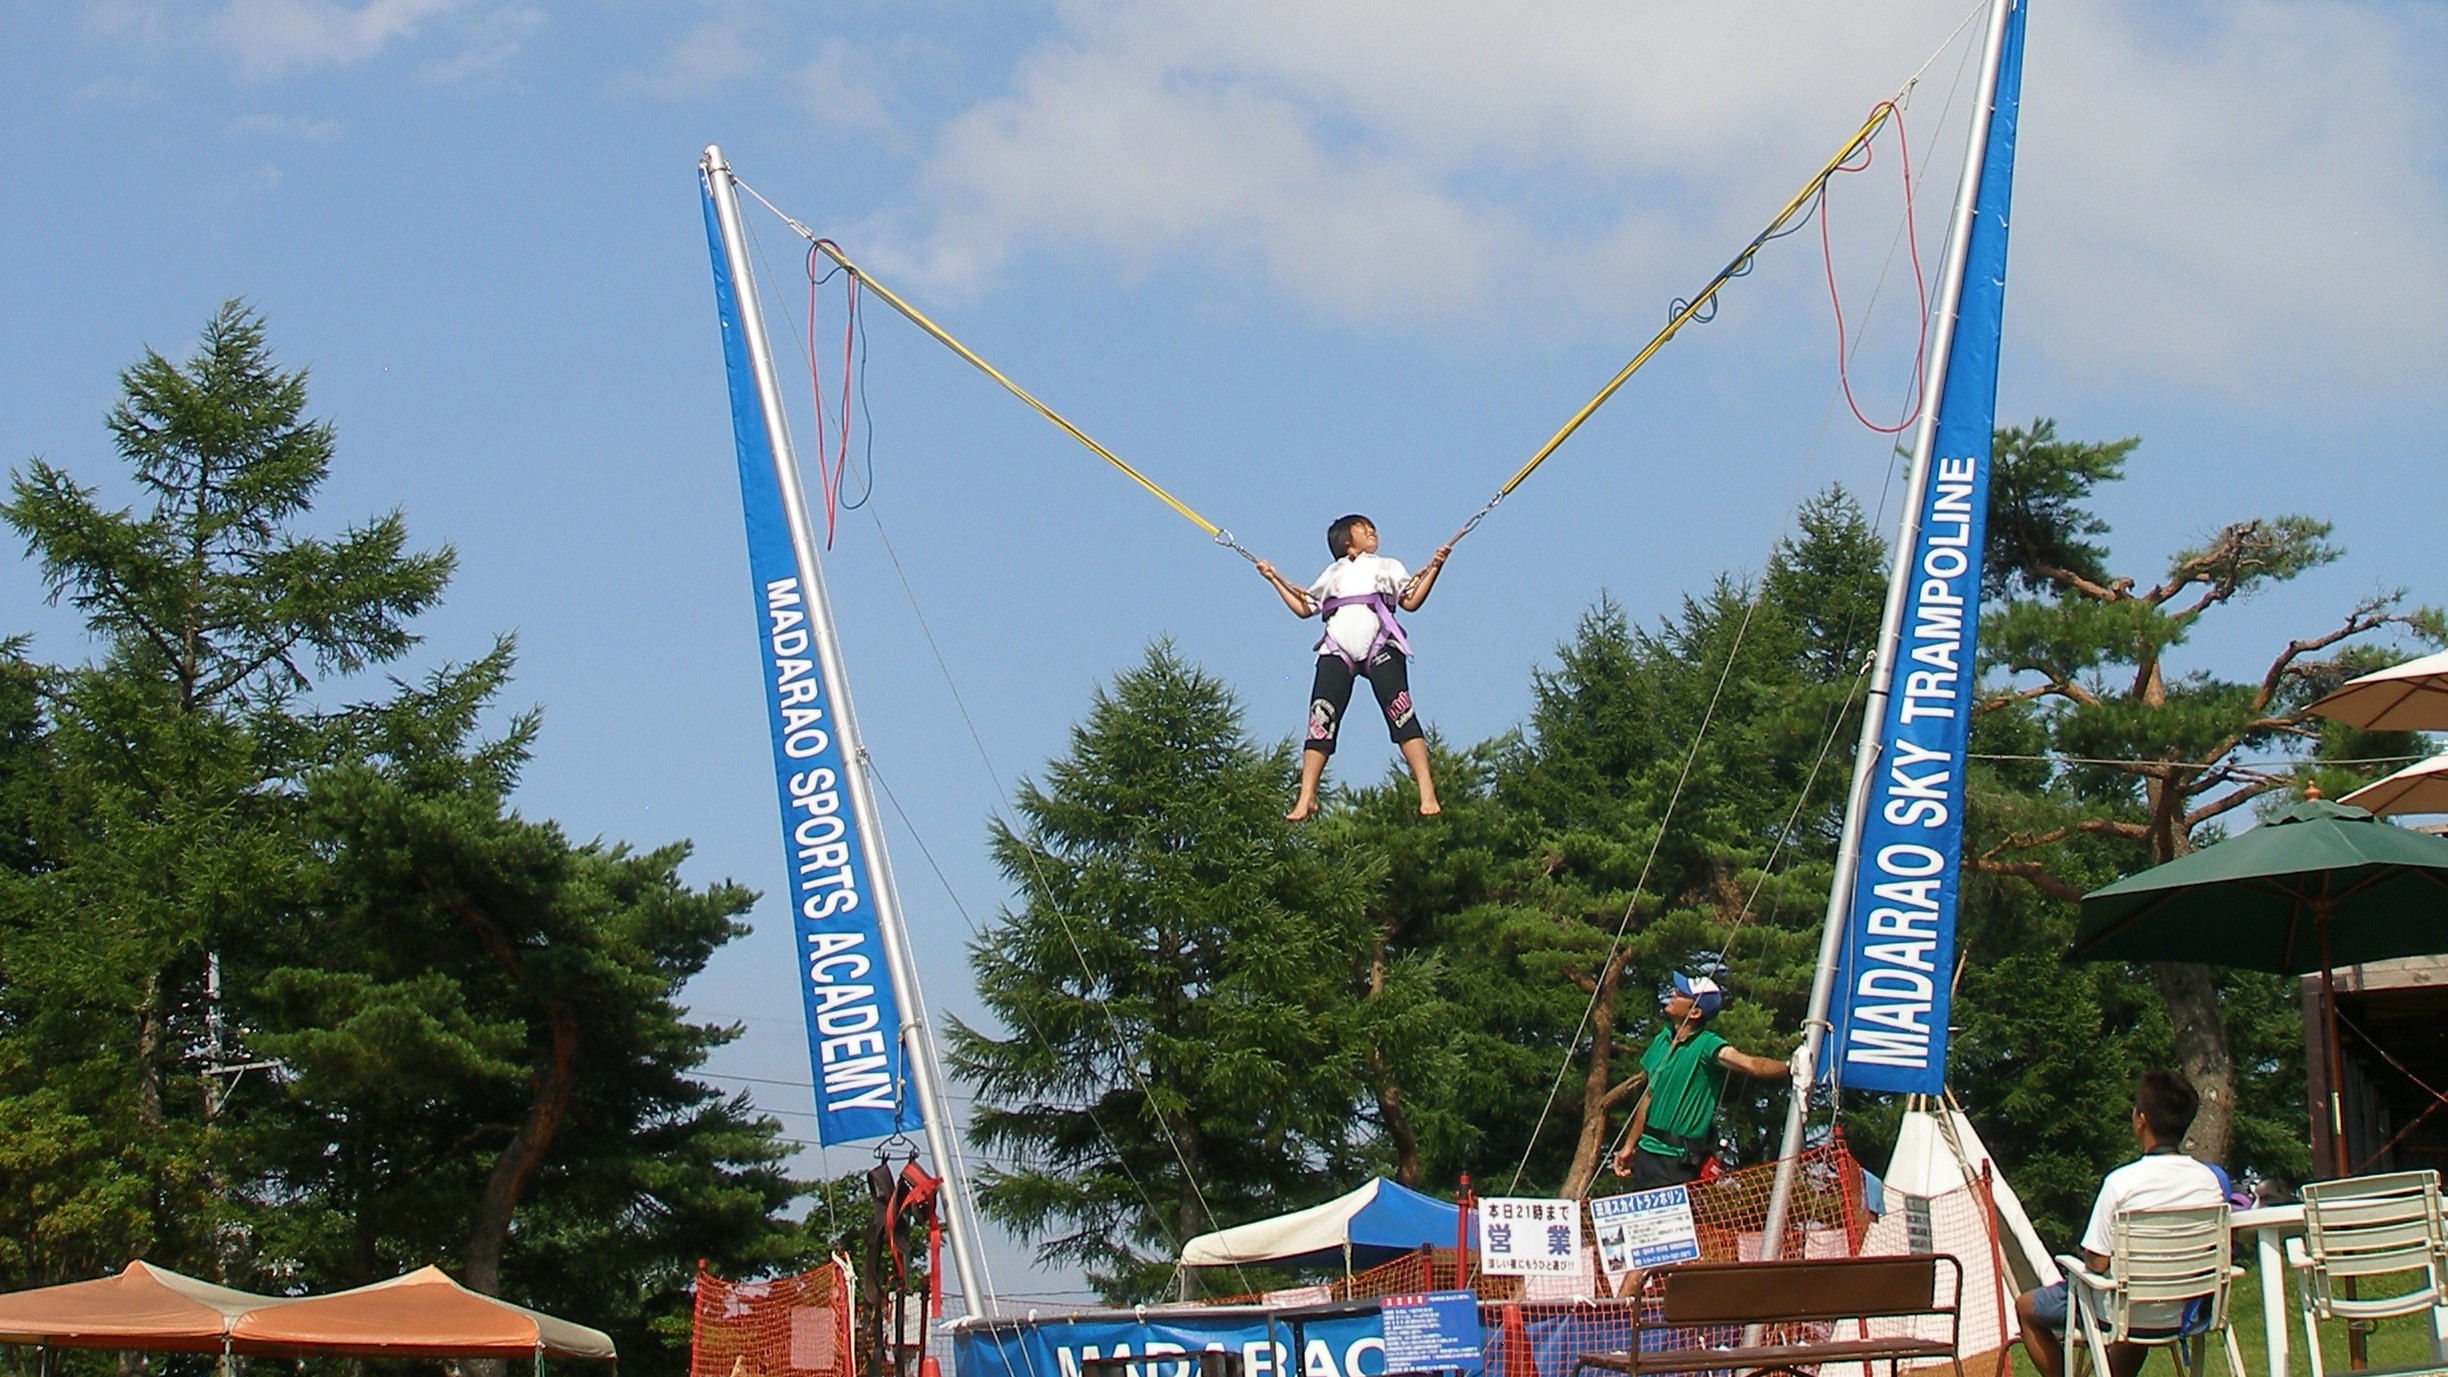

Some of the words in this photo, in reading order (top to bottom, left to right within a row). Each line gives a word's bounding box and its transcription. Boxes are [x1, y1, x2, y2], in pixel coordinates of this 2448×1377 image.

[767, 576, 829, 759] MADARAO
[1900, 456, 1975, 725] TRAMPOLINE
[789, 767, 859, 920] SPORTS
[1883, 738, 1951, 829] SKY
[807, 932, 896, 1113] ACADEMY
[1847, 843, 1944, 1069] MADARAO
[1488, 1203, 1569, 1220] 本日21時まで
[1056, 1337, 1385, 1377] MDRAO
